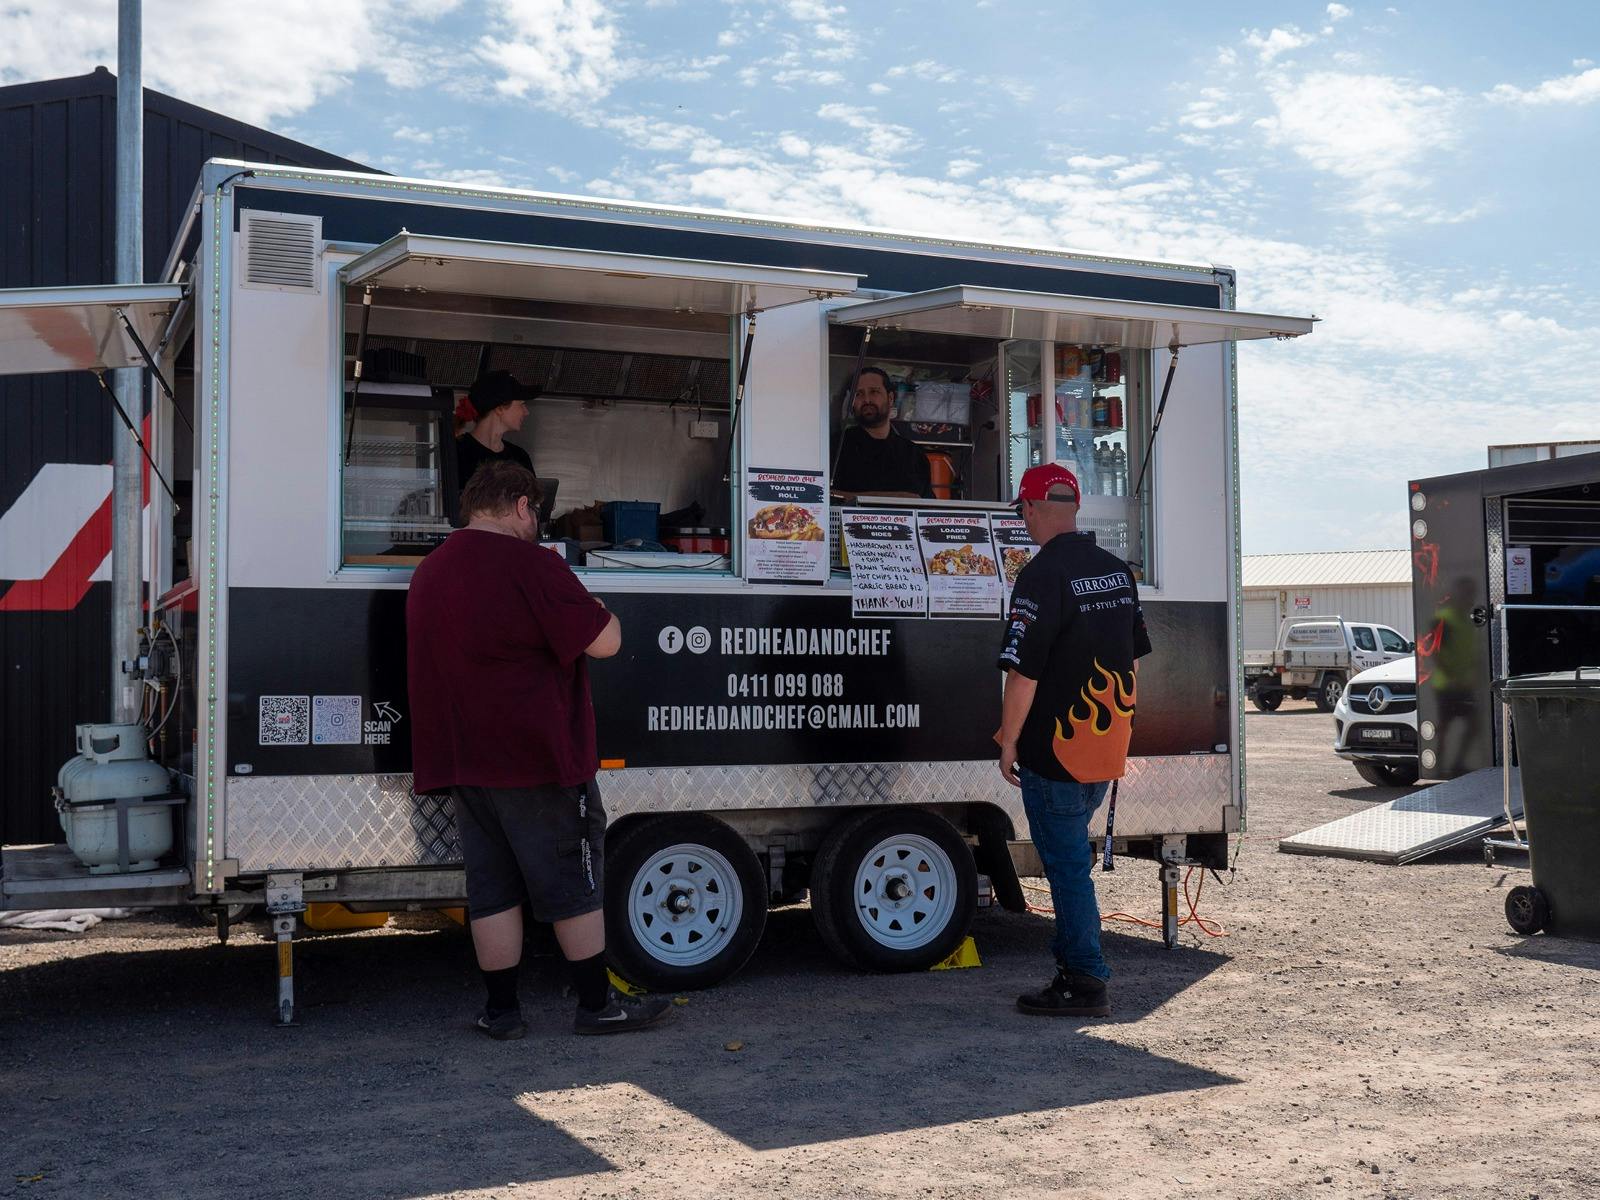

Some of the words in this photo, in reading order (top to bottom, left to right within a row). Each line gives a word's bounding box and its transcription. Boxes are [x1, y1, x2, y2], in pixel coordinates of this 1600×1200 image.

[849, 542, 893, 550] HASHBROWNS
[904, 543, 915, 551] $5
[899, 555, 912, 563] $15
[855, 563, 878, 571] PRAWN
[871, 573, 892, 581] CHIPS
[894, 573, 909, 581] $12
[884, 582, 908, 591] BREAD
[909, 583, 922, 592] $12
[1074, 575, 1128, 593] SIRROMET
[1095, 600, 1118, 610] STYLE
[720, 627, 892, 656] REDHEADANDCHEF
[727, 673, 768, 698] 0411
[774, 673, 807, 698] 099
[811, 673, 844, 698] 088
[648, 703, 921, 732] REDHEADANDCHEF@GMAIL.COM
[364, 721, 391, 733] SCAN
[364, 733, 391, 745] HERE
